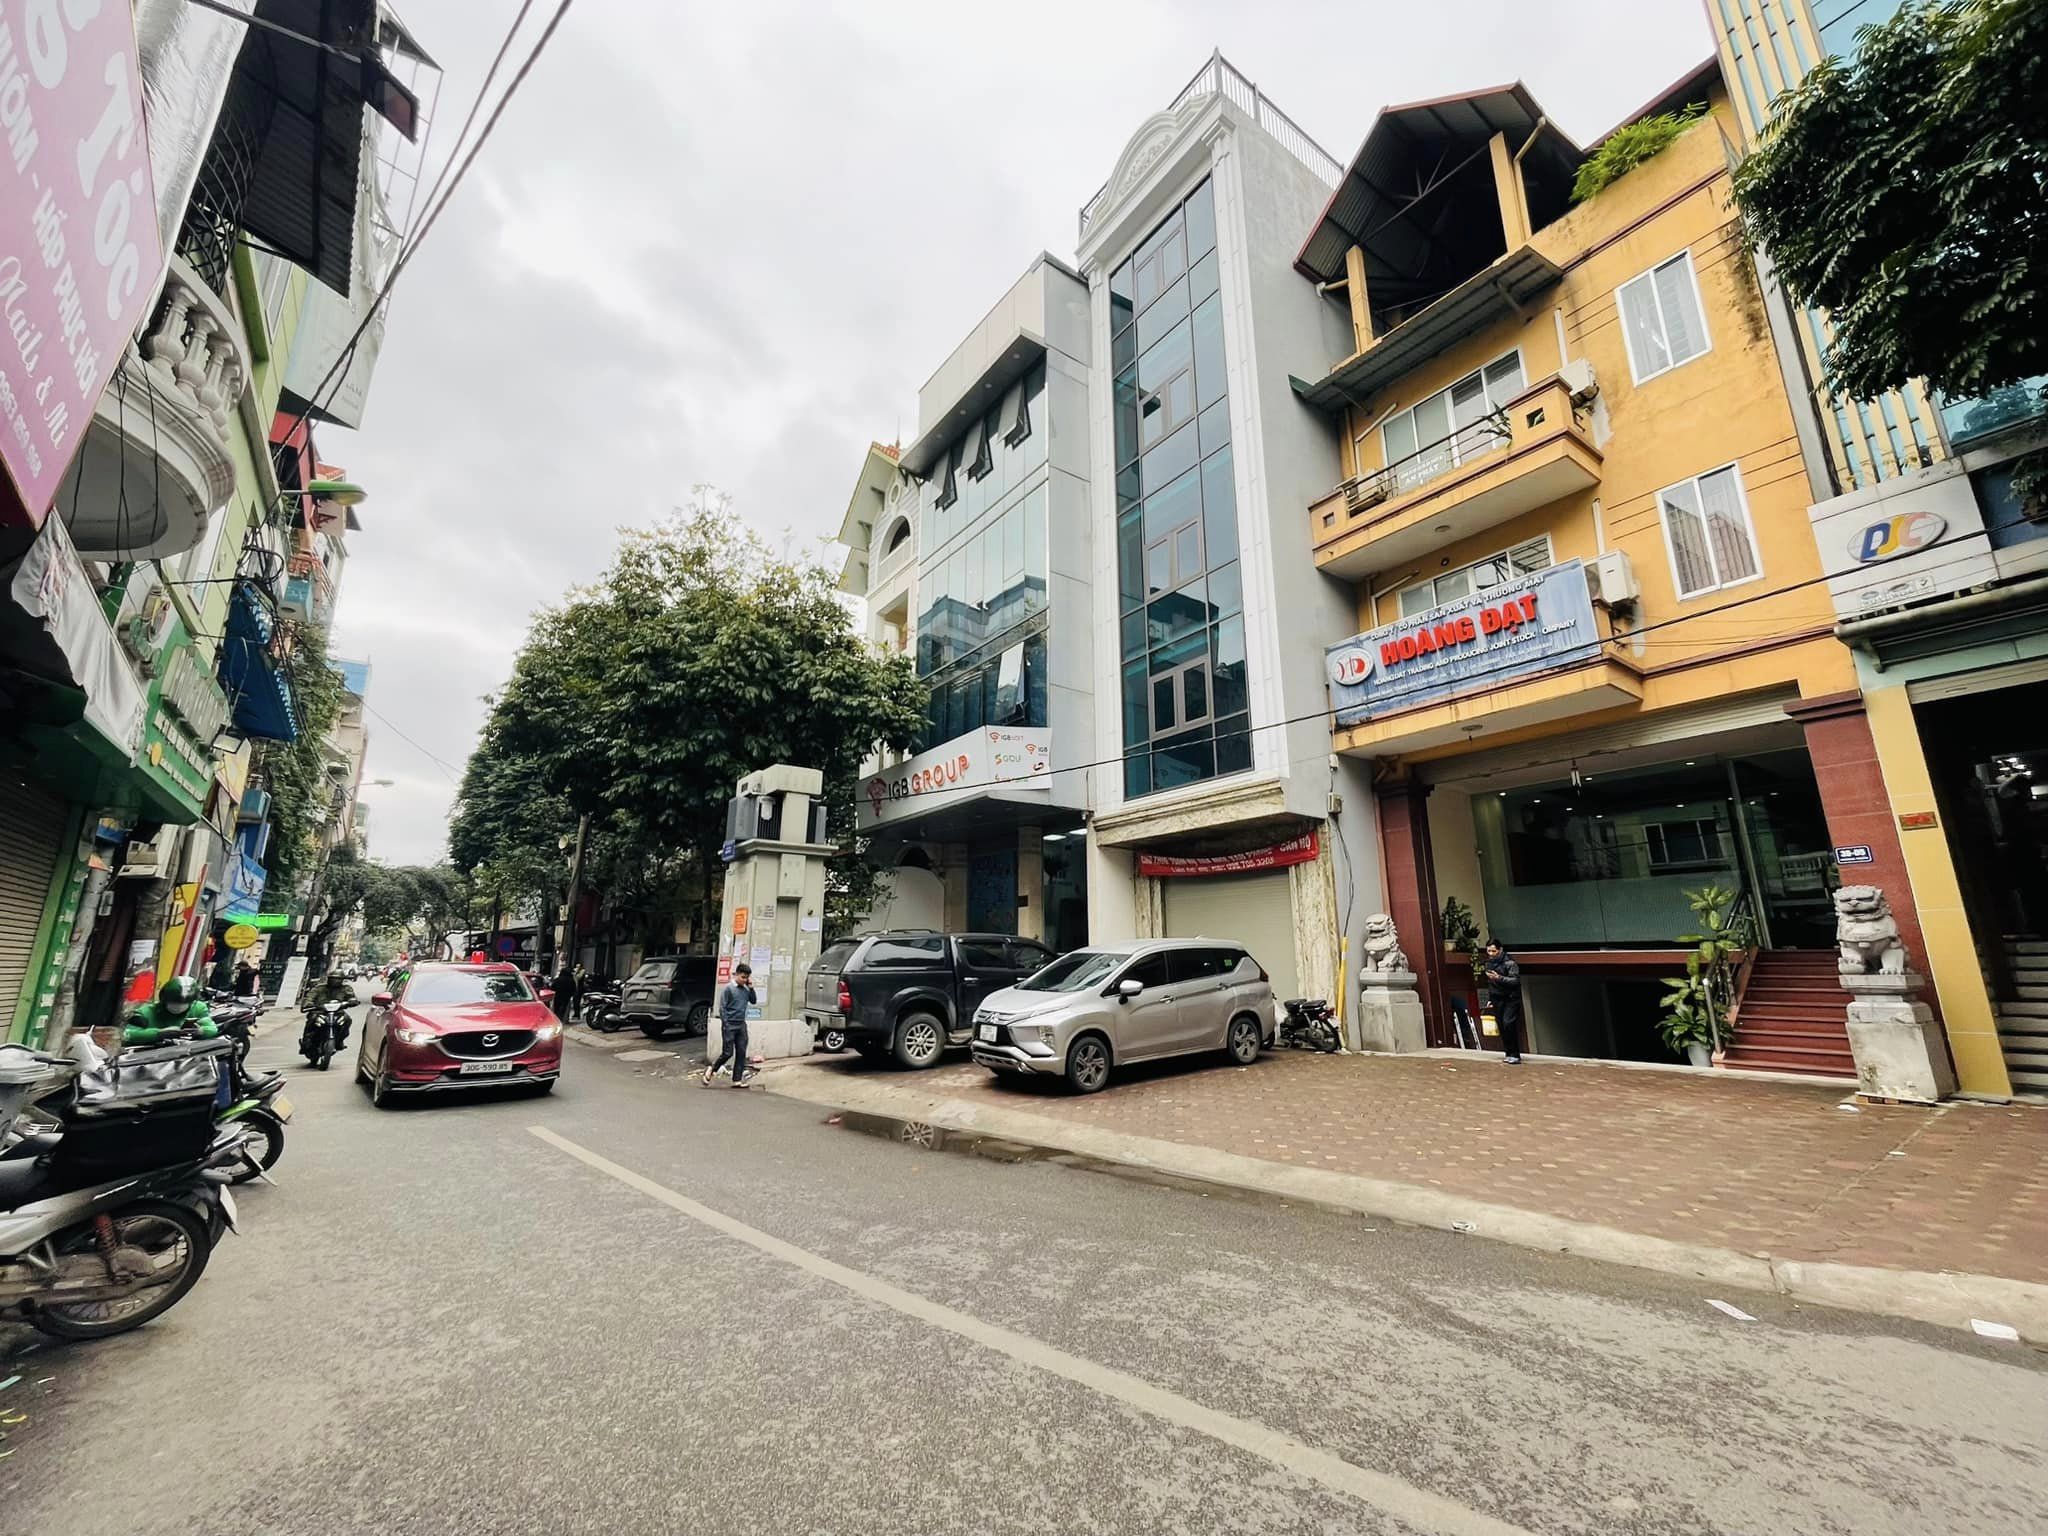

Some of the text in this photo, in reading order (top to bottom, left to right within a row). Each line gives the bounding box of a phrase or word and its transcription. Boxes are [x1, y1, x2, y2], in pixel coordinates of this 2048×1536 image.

[1380, 593, 1538, 667] HOÀNG ĐẠT
[1511, 631, 1537, 645] STOCK
[911, 754, 970, 794] GROUP
